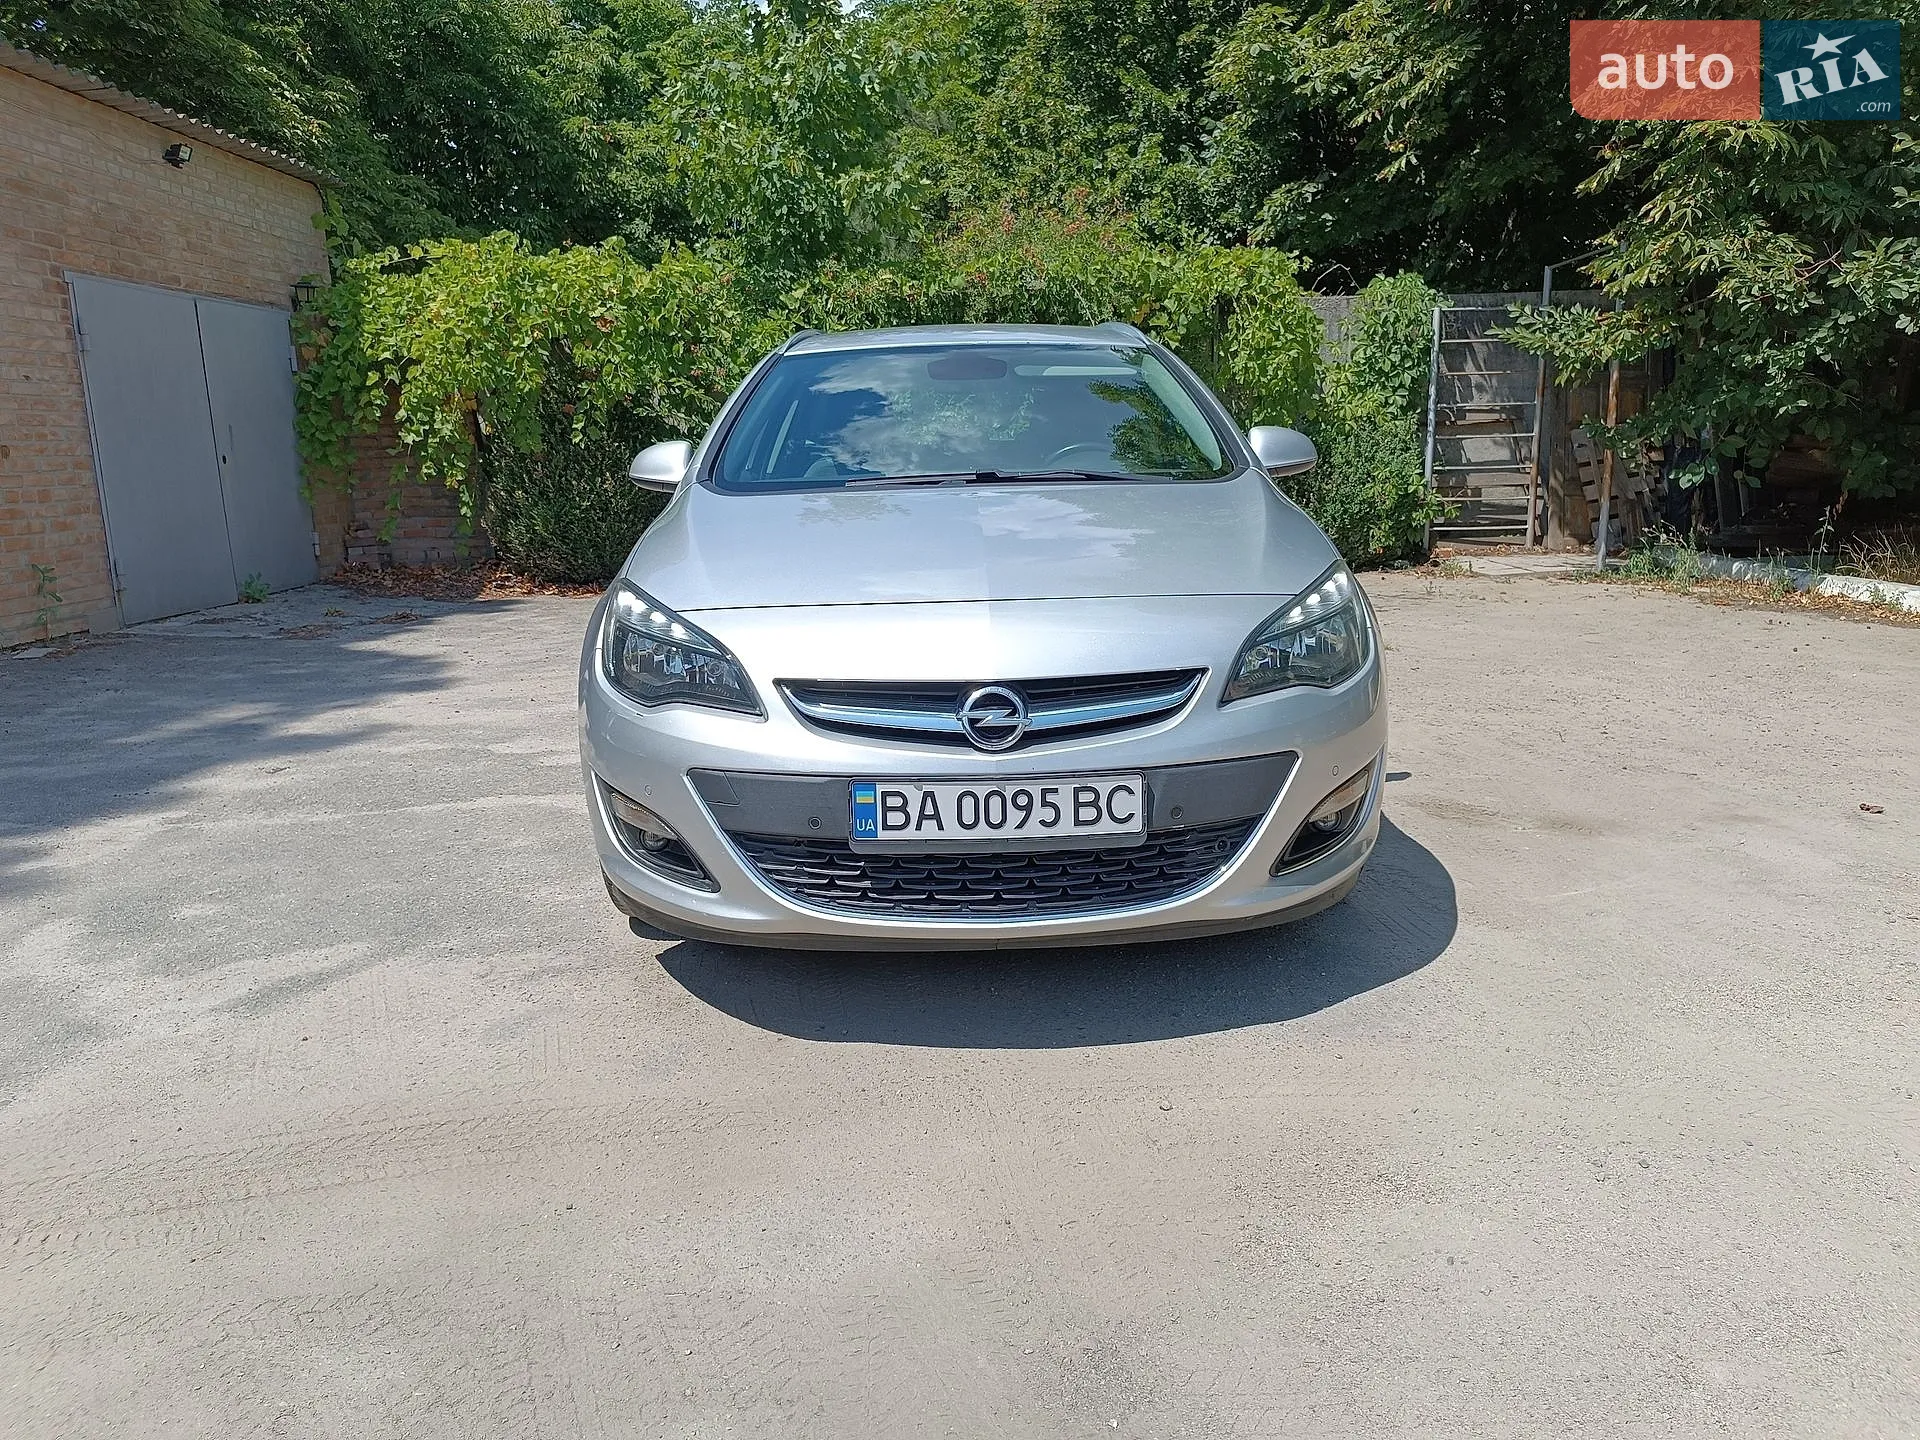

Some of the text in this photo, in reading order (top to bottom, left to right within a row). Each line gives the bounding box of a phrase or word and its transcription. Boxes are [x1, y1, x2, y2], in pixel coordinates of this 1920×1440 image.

[880, 785, 1135, 830] BA 0095 BC
[857, 818, 875, 832] UA
